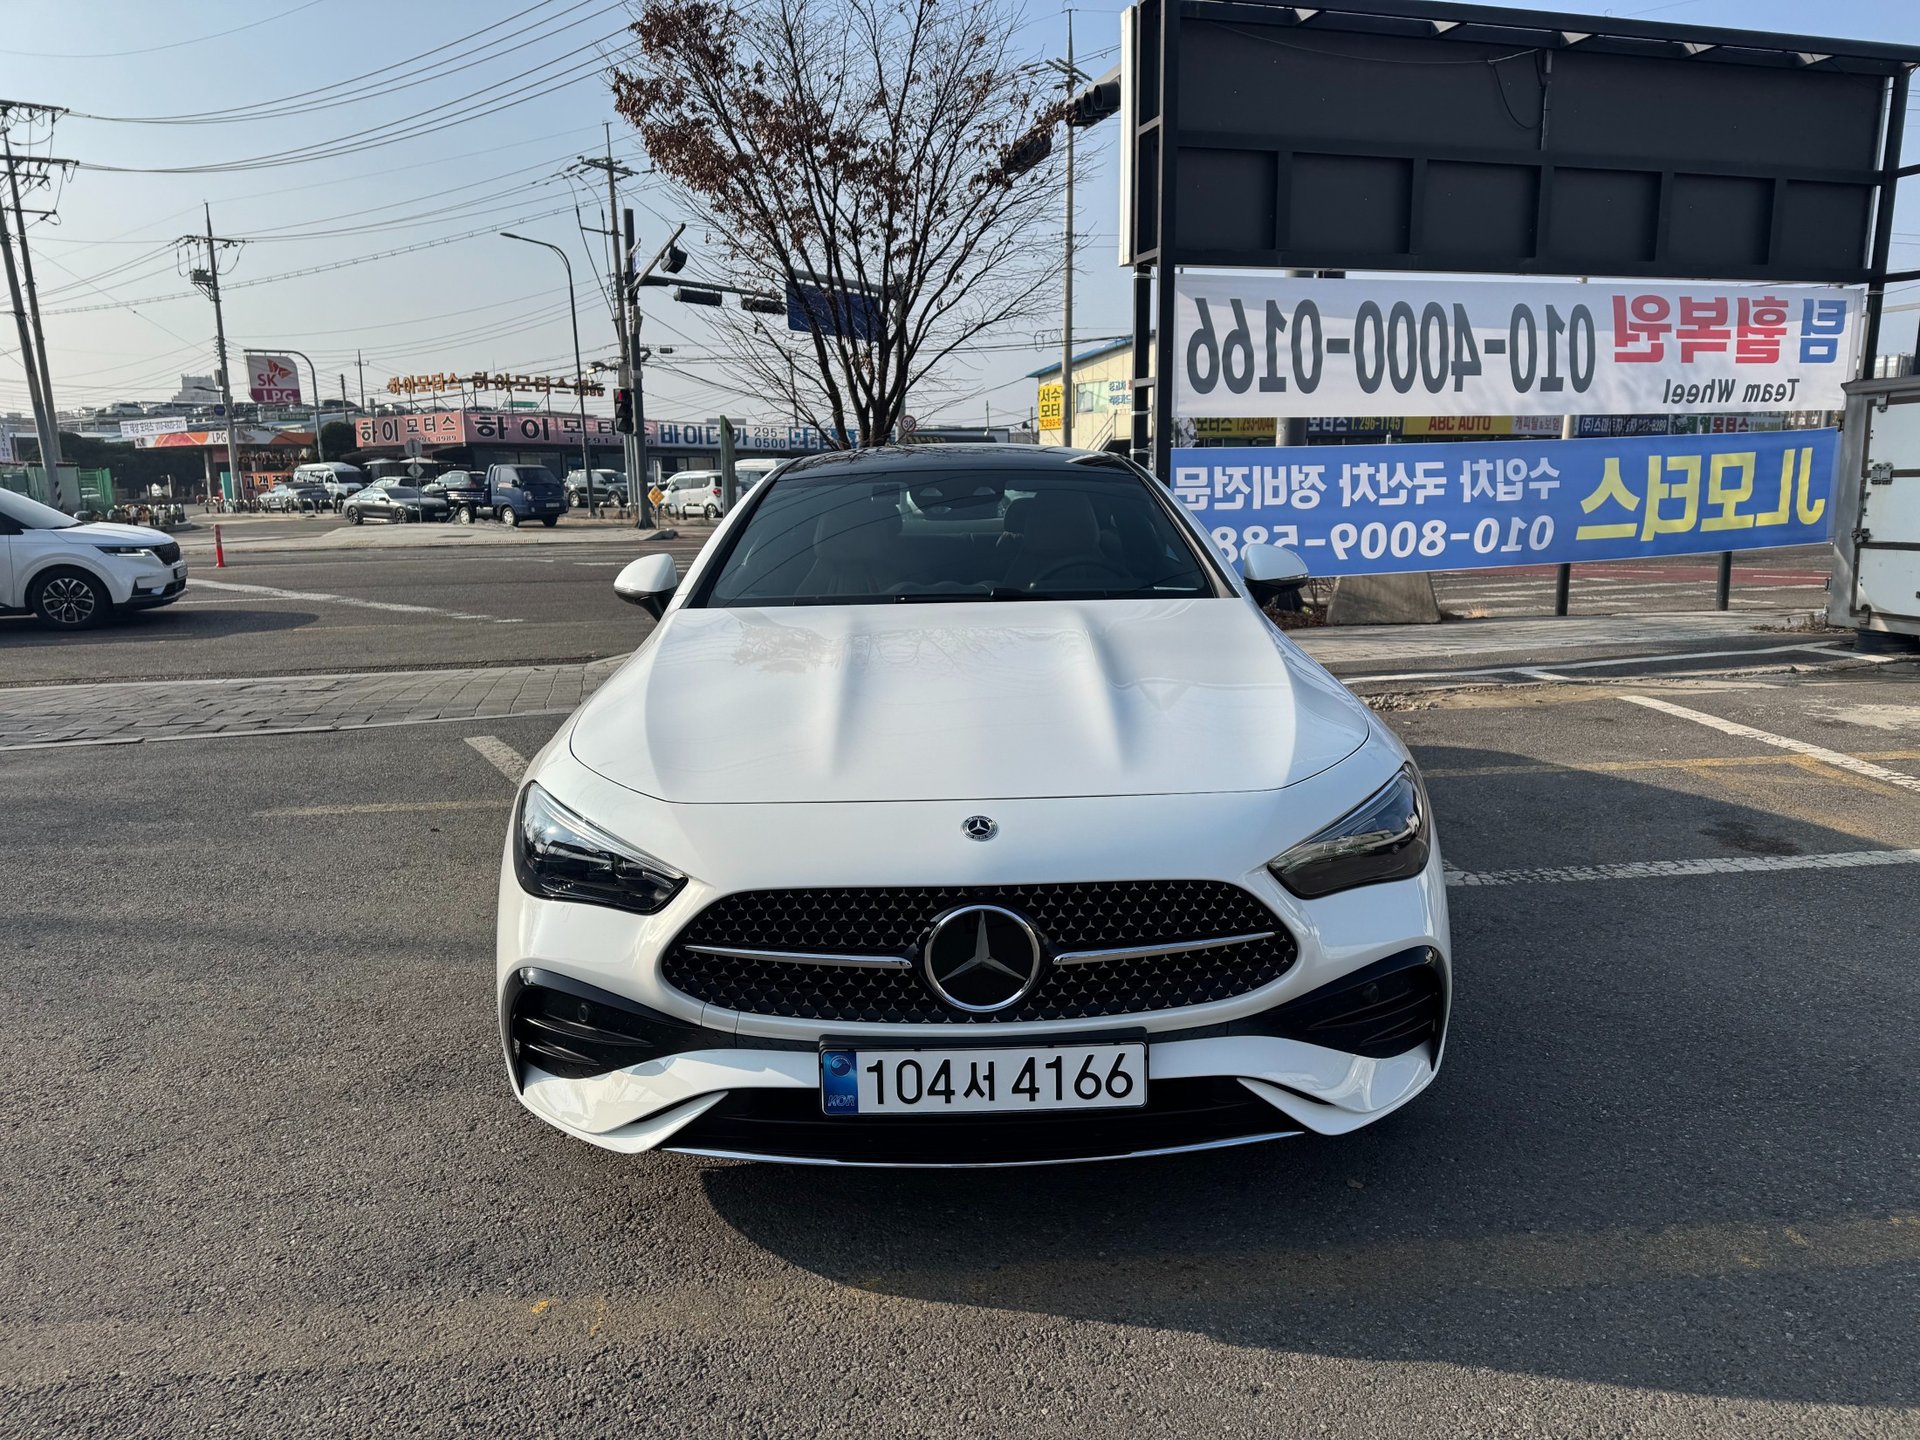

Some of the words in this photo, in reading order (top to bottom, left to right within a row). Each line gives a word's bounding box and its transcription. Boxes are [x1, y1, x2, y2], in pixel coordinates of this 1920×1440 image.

[257, 373, 278, 387] SK
[387, 372, 462, 396] 하이모터스
[472, 371, 571, 395] 하이모터스
[263, 389, 294, 403] LPG
[1040, 389, 1061, 403] 서수
[1041, 403, 1061, 418] 모터
[360, 416, 401, 445] 하이
[406, 415, 456, 434] 모터스
[474, 415, 550, 441] 하이
[903, 419, 914, 429] 30
[1428, 416, 1454, 431] ABC
[1458, 416, 1491, 431] AUTO
[212, 431, 227, 444] LPG
[754, 437, 786, 449] 0500
[866, 1058, 996, 1105] 104서
[1011, 1052, 1134, 1102] 4166
[827, 1094, 855, 1107] KOR
